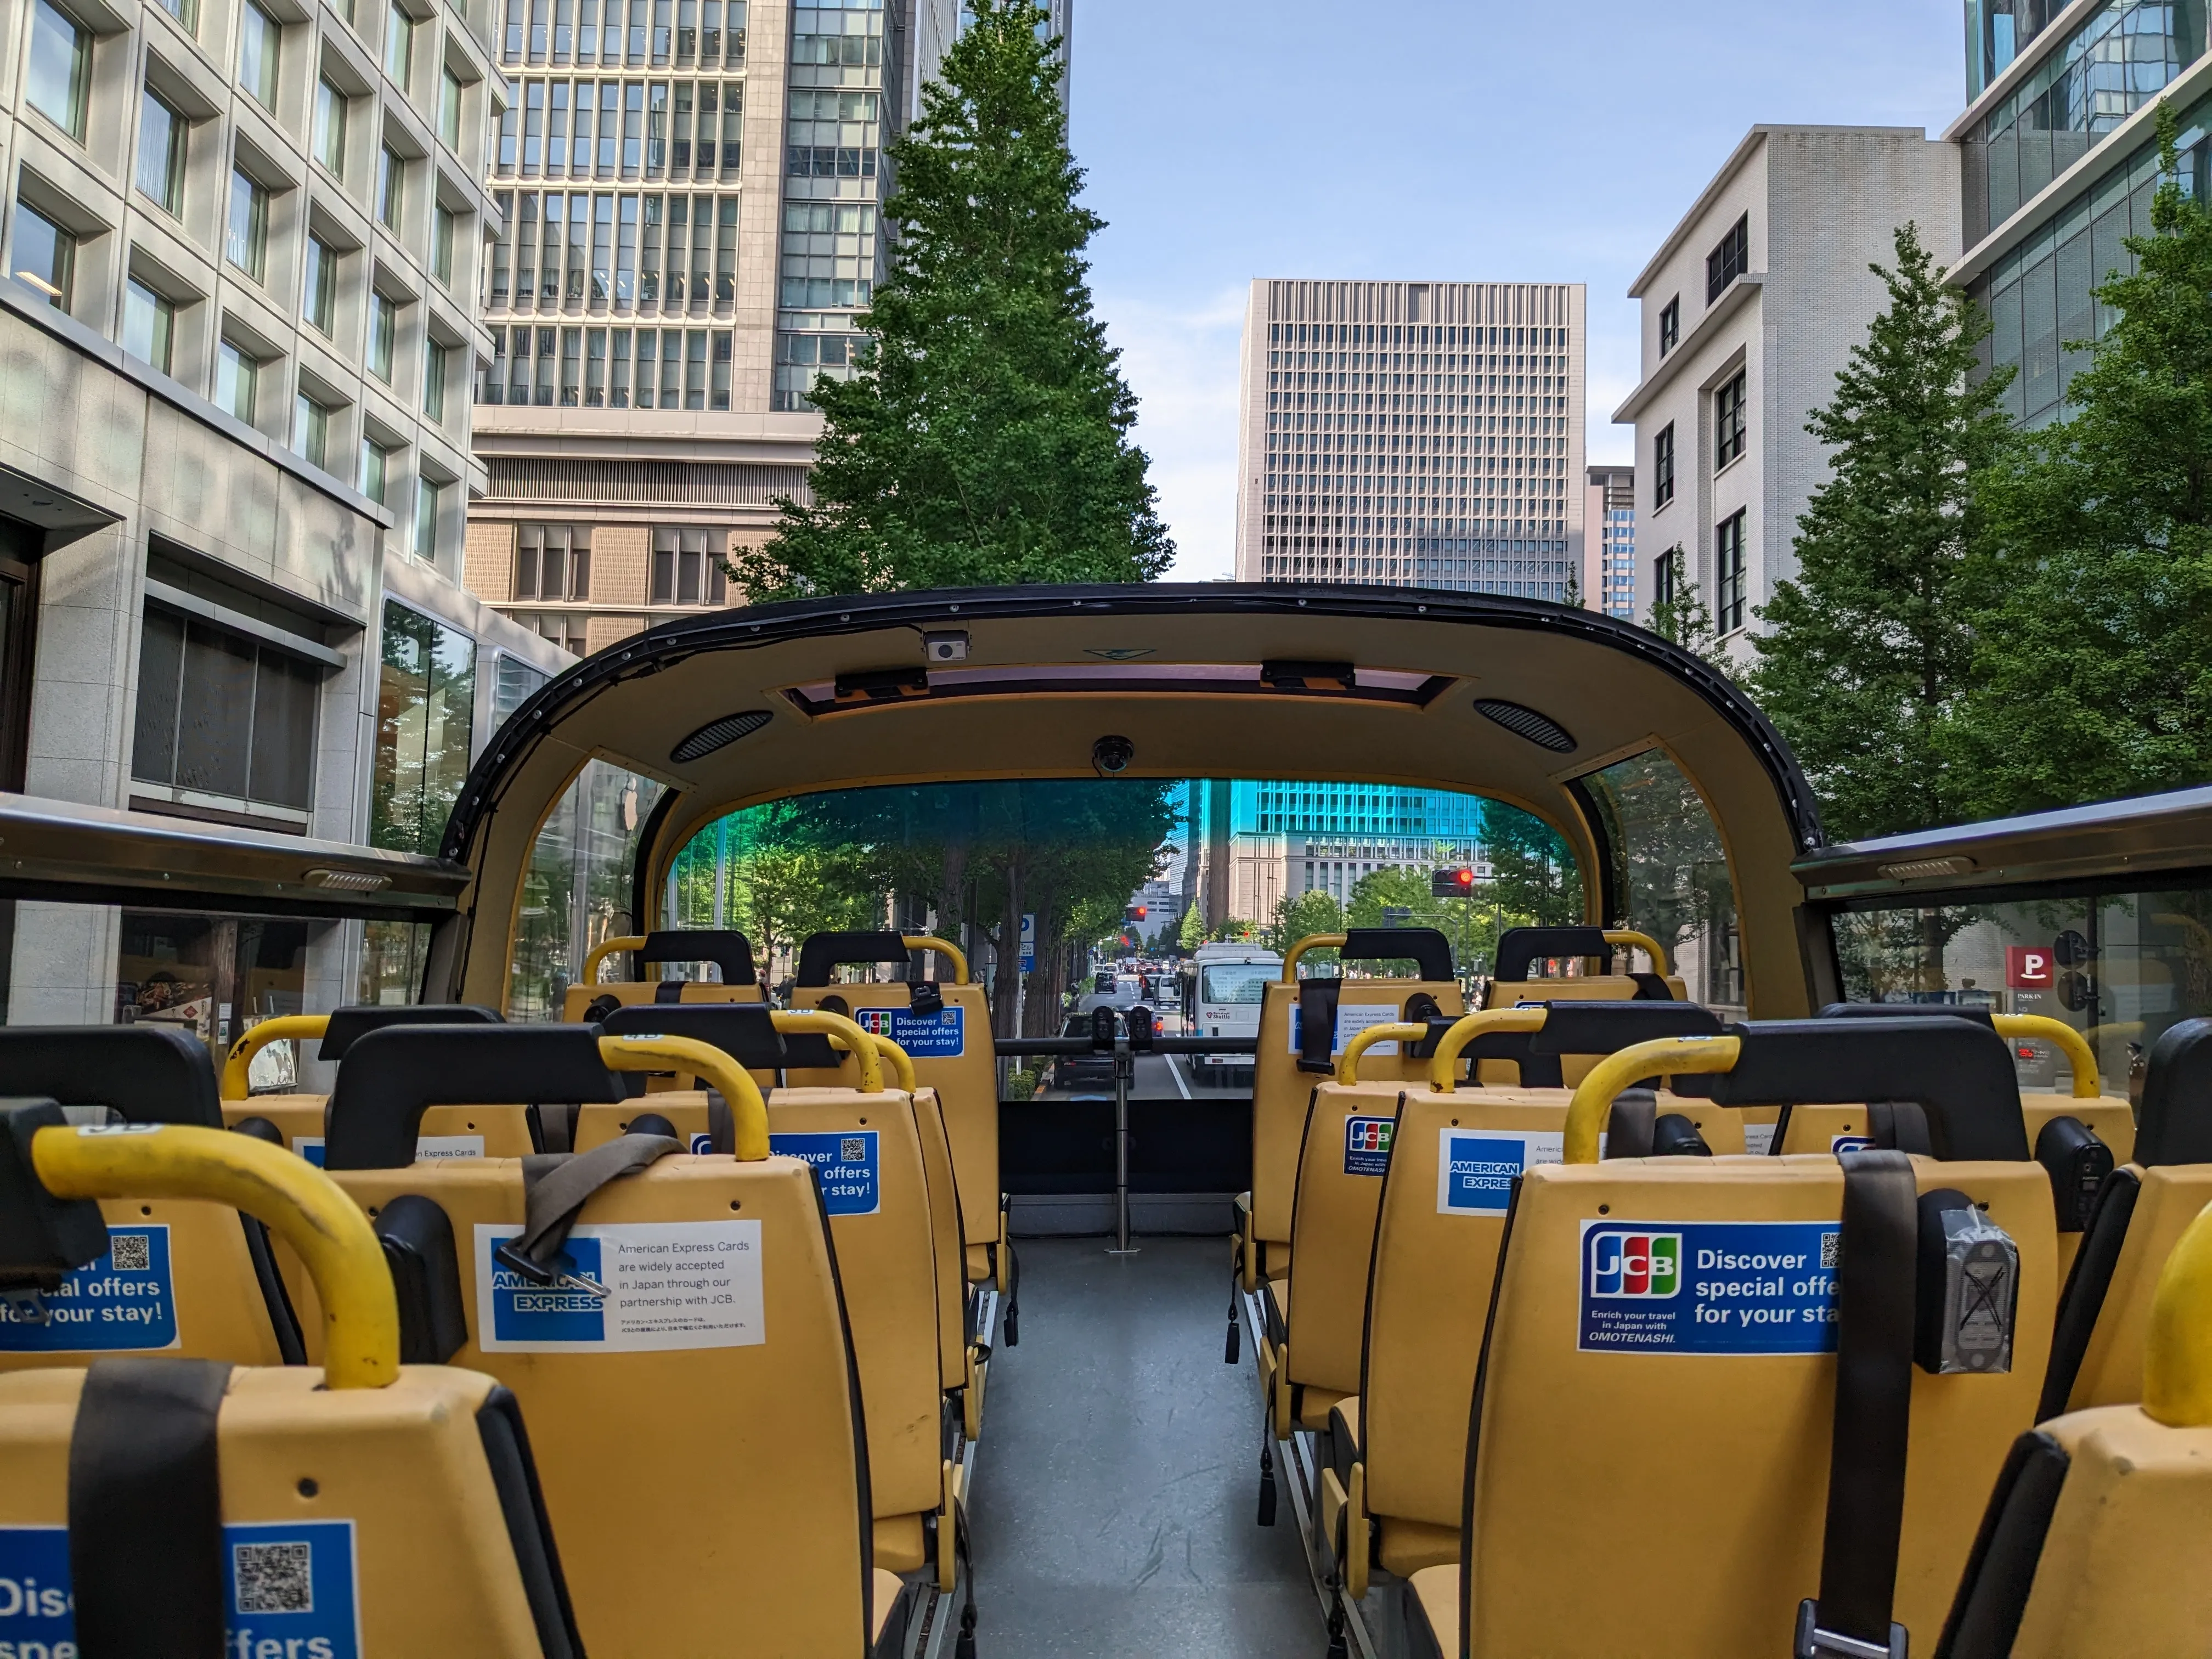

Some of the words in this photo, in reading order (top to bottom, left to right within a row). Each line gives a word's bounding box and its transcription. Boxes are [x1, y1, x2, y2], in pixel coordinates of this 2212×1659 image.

[2025, 954, 2044, 974] P
[896, 1017, 937, 1026] Discover
[896, 1027, 929, 1037] special
[932, 1027, 959, 1036] offers
[896, 1037, 910, 1046] for
[912, 1039, 934, 1047] your
[936, 1037, 959, 1046] stay!
[824, 1166, 871, 1180] offers
[1451, 1162, 1519, 1173] AMERICAN
[1464, 1177, 1511, 1188] EXPRE
[831, 1182, 871, 1197] stay!
[618, 1244, 669, 1254] American
[672, 1243, 714, 1254] Express
[718, 1241, 749, 1251] Cards
[1697, 1249, 1807, 1270] Discover
[639, 1262, 672, 1273] widely
[675, 1260, 725, 1271] accepted
[88, 1277, 161, 1297] offers
[619, 1281, 629, 1289] in
[631, 1280, 664, 1290] Japan
[667, 1278, 709, 1289] through
[713, 1278, 731, 1287] our
[1695, 1276, 1783, 1301] special
[1792, 1276, 1839, 1296] offe
[516, 1295, 603, 1310] EXPRESS
[620, 1296, 682, 1309] partnership
[685, 1295, 708, 1305] with
[711, 1294, 736, 1304] JCB.
[101, 1302, 162, 1325] stay!
[1591, 1310, 1622, 1319] Enrich
[1624, 1312, 1646, 1321] your
[1648, 1312, 1675, 1320] travel
[1695, 1303, 1730, 1323] for
[1739, 1307, 1795, 1328] your
[1802, 1305, 1839, 1323] sta
[1602, 1321, 1611, 1329] in
[1613, 1322, 1643, 1331] Japan
[1645, 1322, 1667, 1330] with
[1589, 1332, 1677, 1344] OMOTENASHI.
